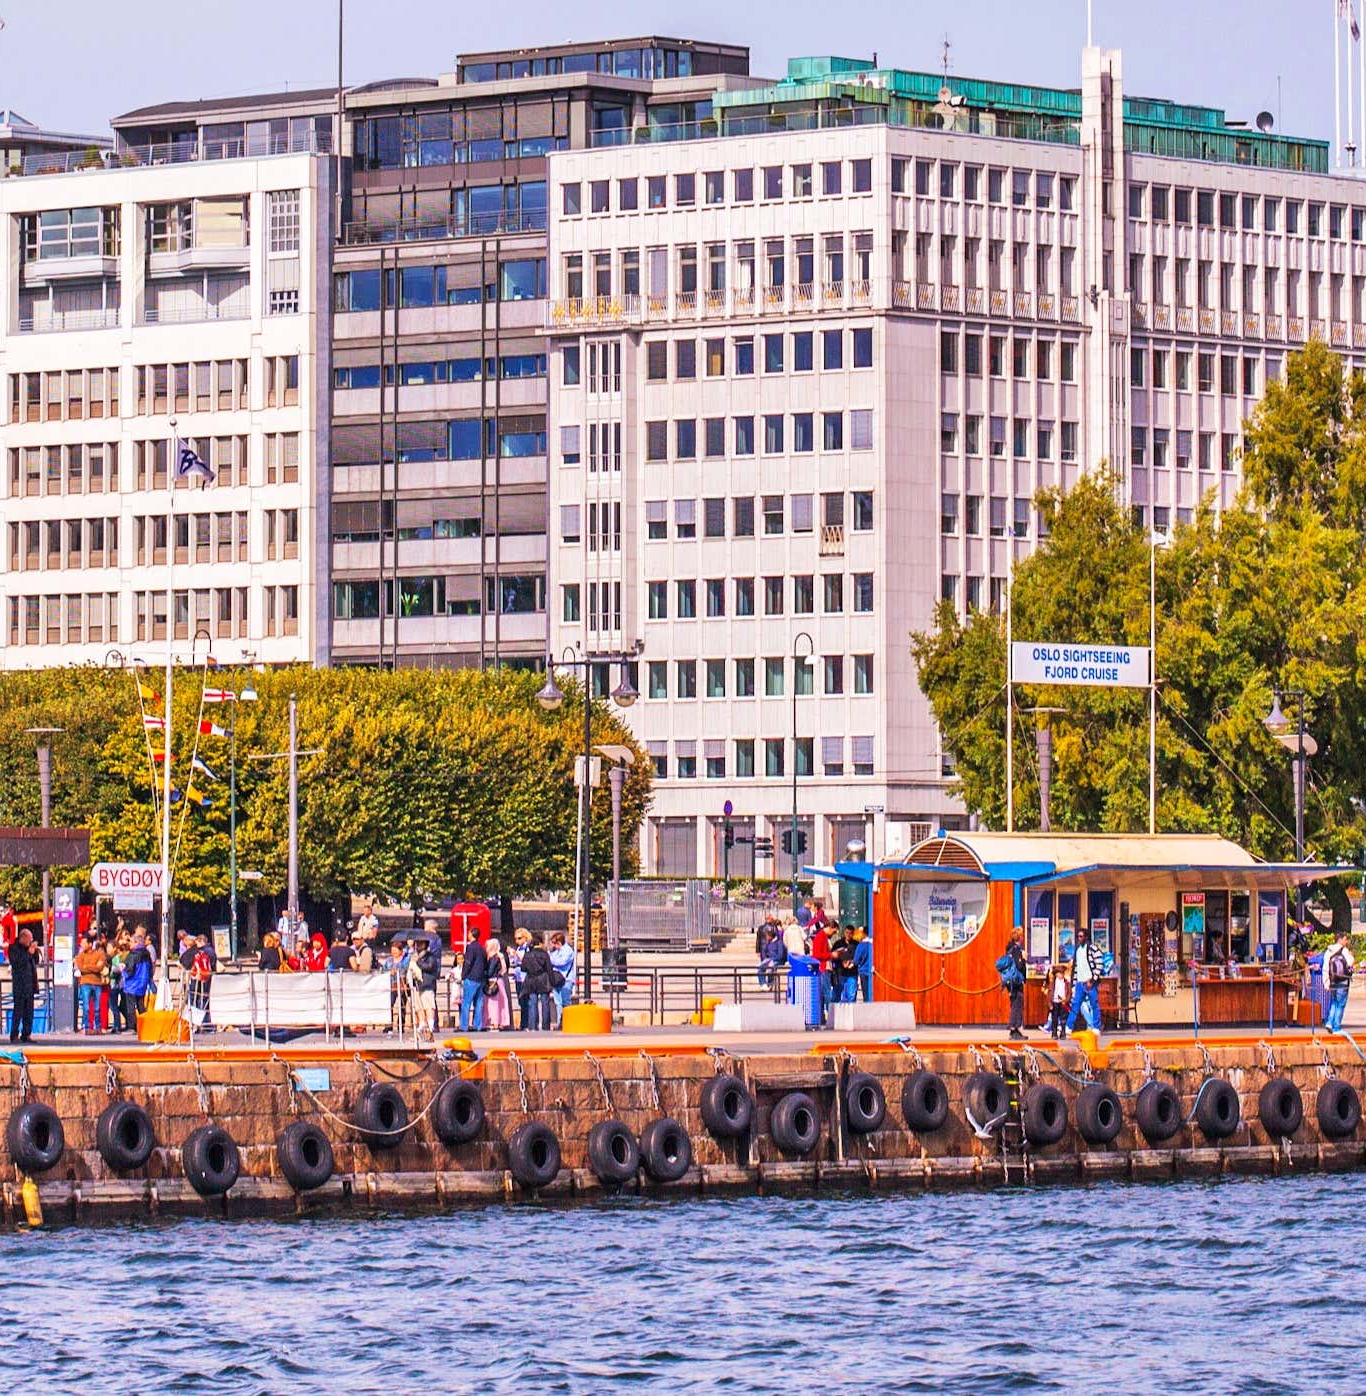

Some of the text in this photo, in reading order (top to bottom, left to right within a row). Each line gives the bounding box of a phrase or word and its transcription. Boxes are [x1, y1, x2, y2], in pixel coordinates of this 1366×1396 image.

[1032, 648, 1130, 664] OSLO SIGHTSEEING
[1045, 666, 1118, 680] FJORD CRUISE
[99, 869, 163, 887] BYGDØY
